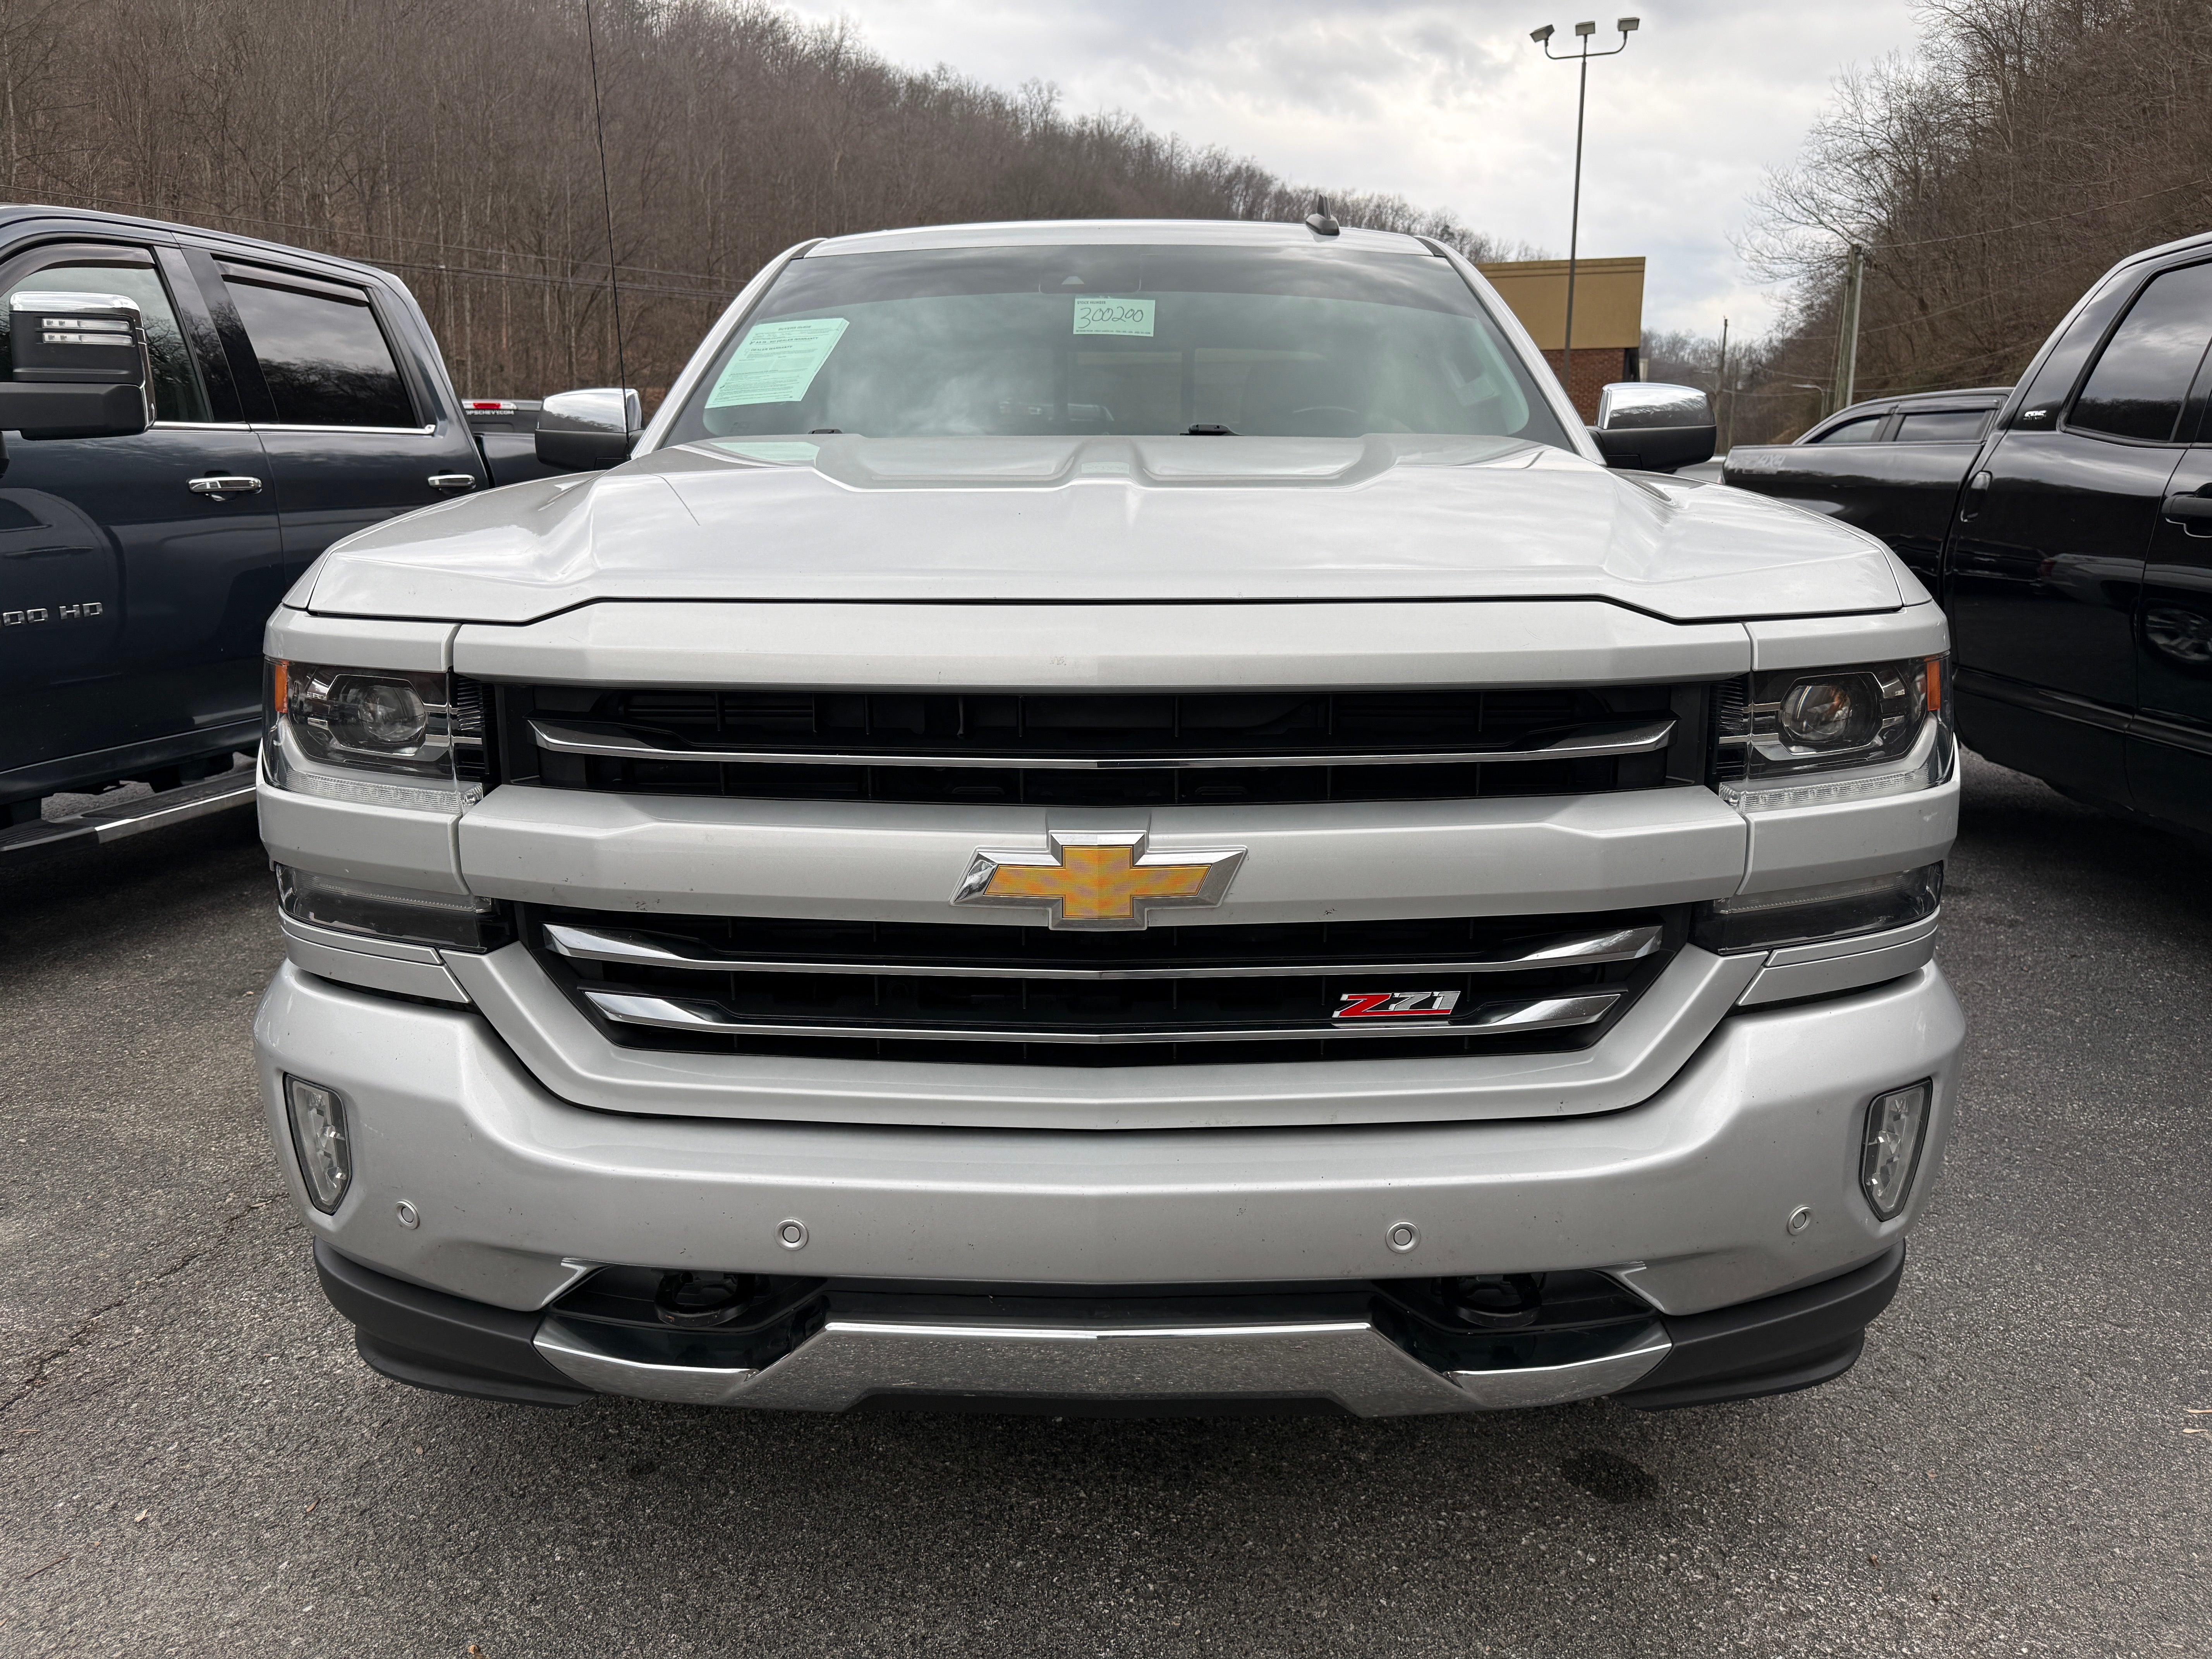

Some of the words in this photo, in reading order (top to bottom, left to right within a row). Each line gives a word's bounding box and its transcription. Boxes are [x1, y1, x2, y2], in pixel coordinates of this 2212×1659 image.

[1078, 306, 1144, 328] 300200
[0, 608, 48, 626] 00
[59, 602, 103, 620] HD
[1332, 991, 1461, 1018] Z71
